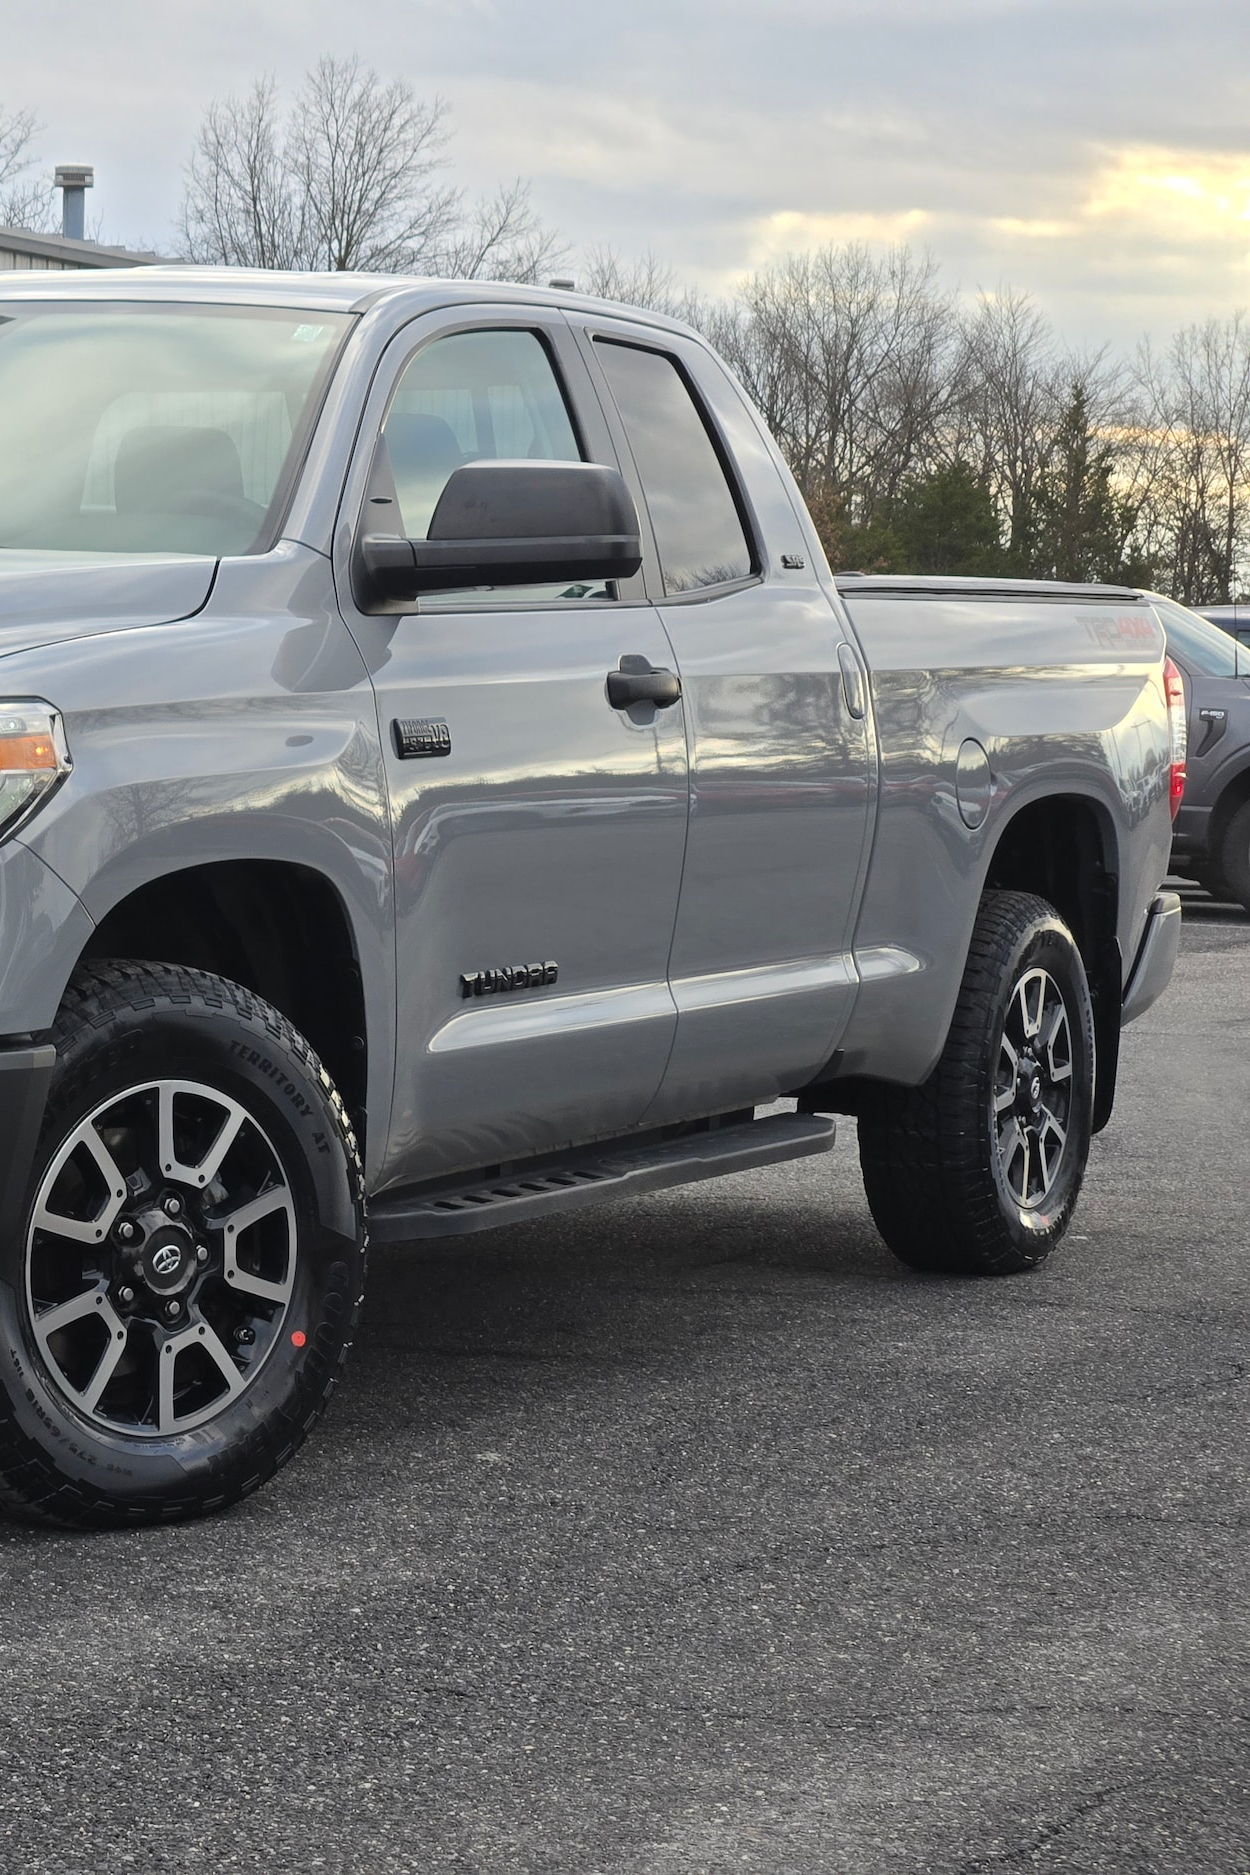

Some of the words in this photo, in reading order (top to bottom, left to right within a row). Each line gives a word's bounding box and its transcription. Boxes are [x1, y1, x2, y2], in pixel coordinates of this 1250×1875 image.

[460, 960, 558, 998] TUNDRA
[229, 1040, 314, 1117] TERRITORY
[311, 1132, 331, 1154] AT
